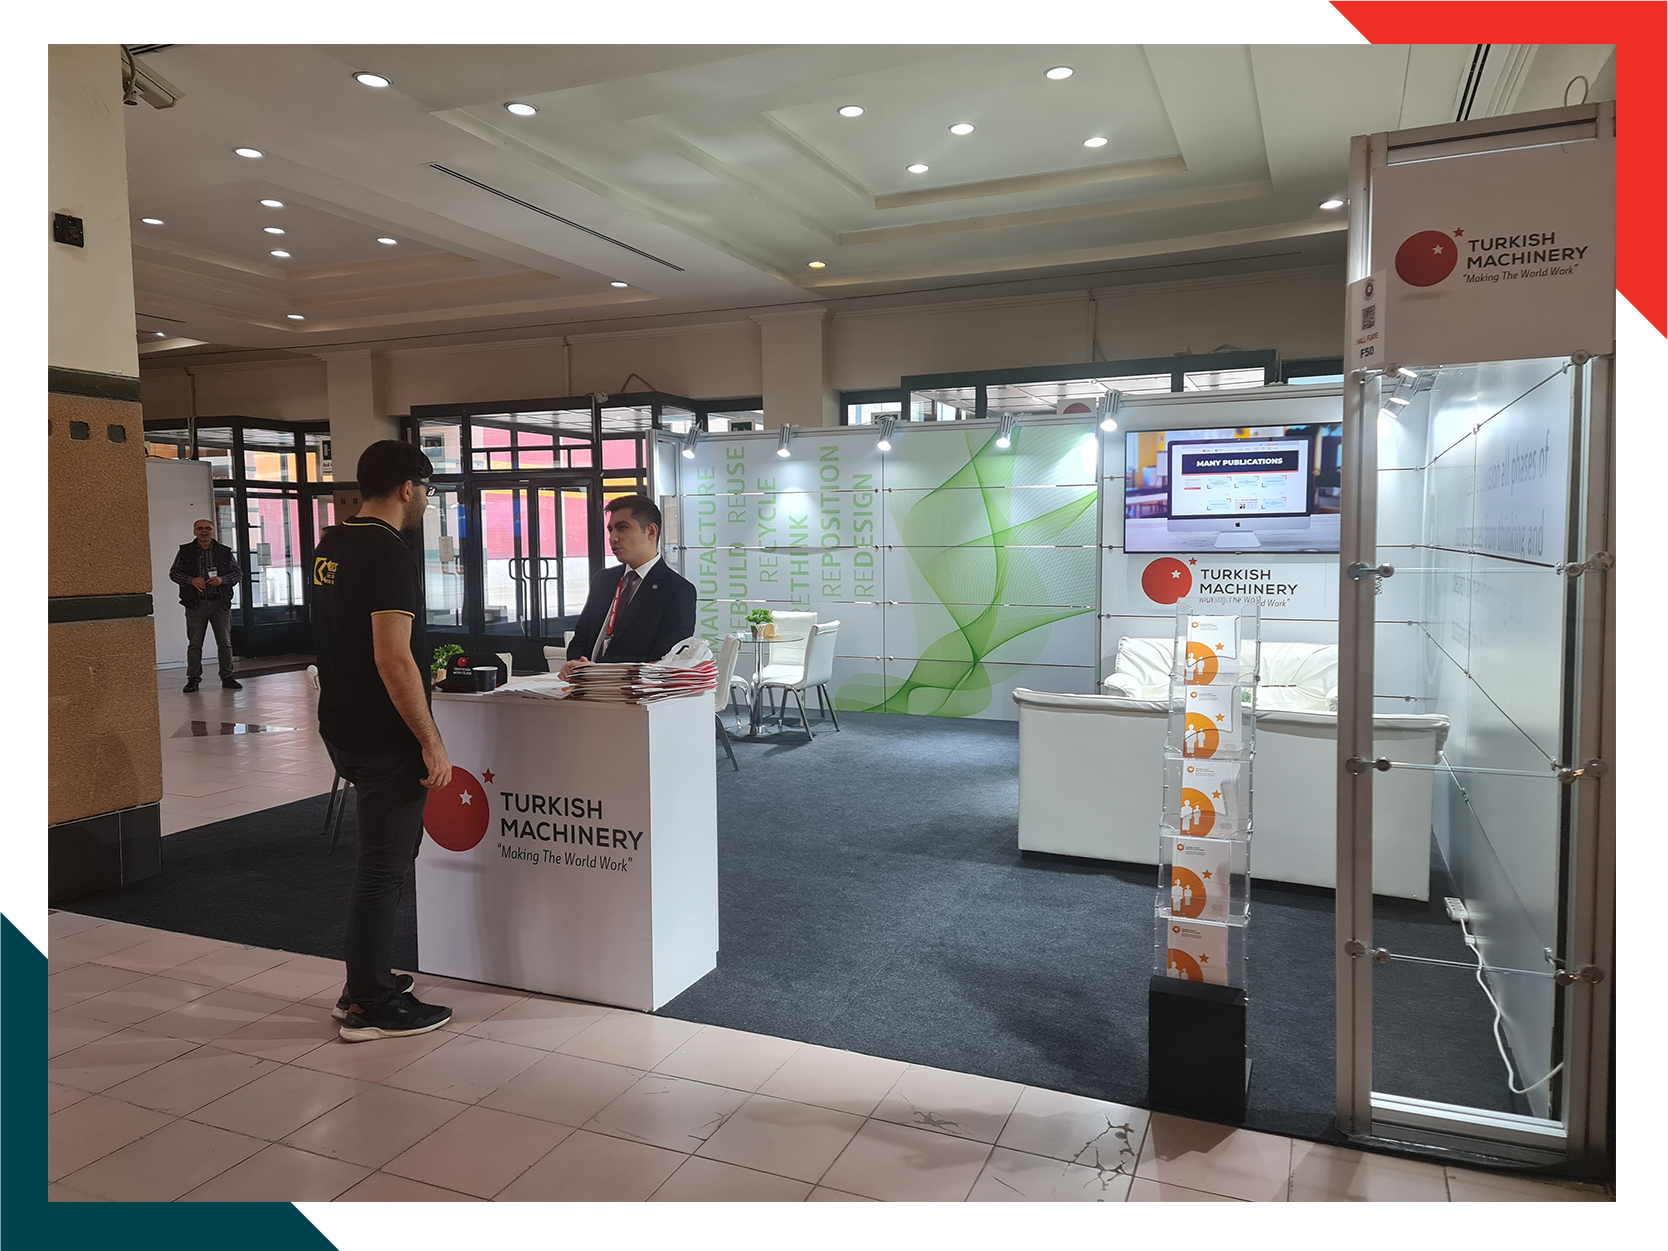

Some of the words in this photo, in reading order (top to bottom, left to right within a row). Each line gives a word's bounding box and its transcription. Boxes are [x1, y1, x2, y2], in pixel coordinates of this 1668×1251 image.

[1467, 246, 1589, 269] MACHINERY
[1468, 232, 1555, 252] TURKISH
[1502, 270, 1518, 280] The
[1521, 267, 1548, 278] World
[1360, 346, 1374, 359] F50
[1222, 458, 1283, 466] PUBLICATIONS
[1511, 442, 1537, 496] phases
[1539, 428, 1550, 480] of
[726, 446, 746, 523] REUSE
[757, 477, 778, 583] RECYCLE
[819, 446, 841, 597] REPOSITION
[852, 474, 874, 598] REDESIGN
[1528, 509, 1545, 556] and
[697, 467, 718, 665] MANUFACTURE
[789, 515, 810, 612] ETHINK
[1201, 569, 1271, 580] TURKISH
[728, 542, 748, 629] EBUILD
[1200, 583, 1298, 595] MACHINERY
[500, 792, 603, 820] TURKISH
[500, 817, 644, 851] MACHINERY
[542, 849, 562, 865] The
[564, 851, 597, 869] World
